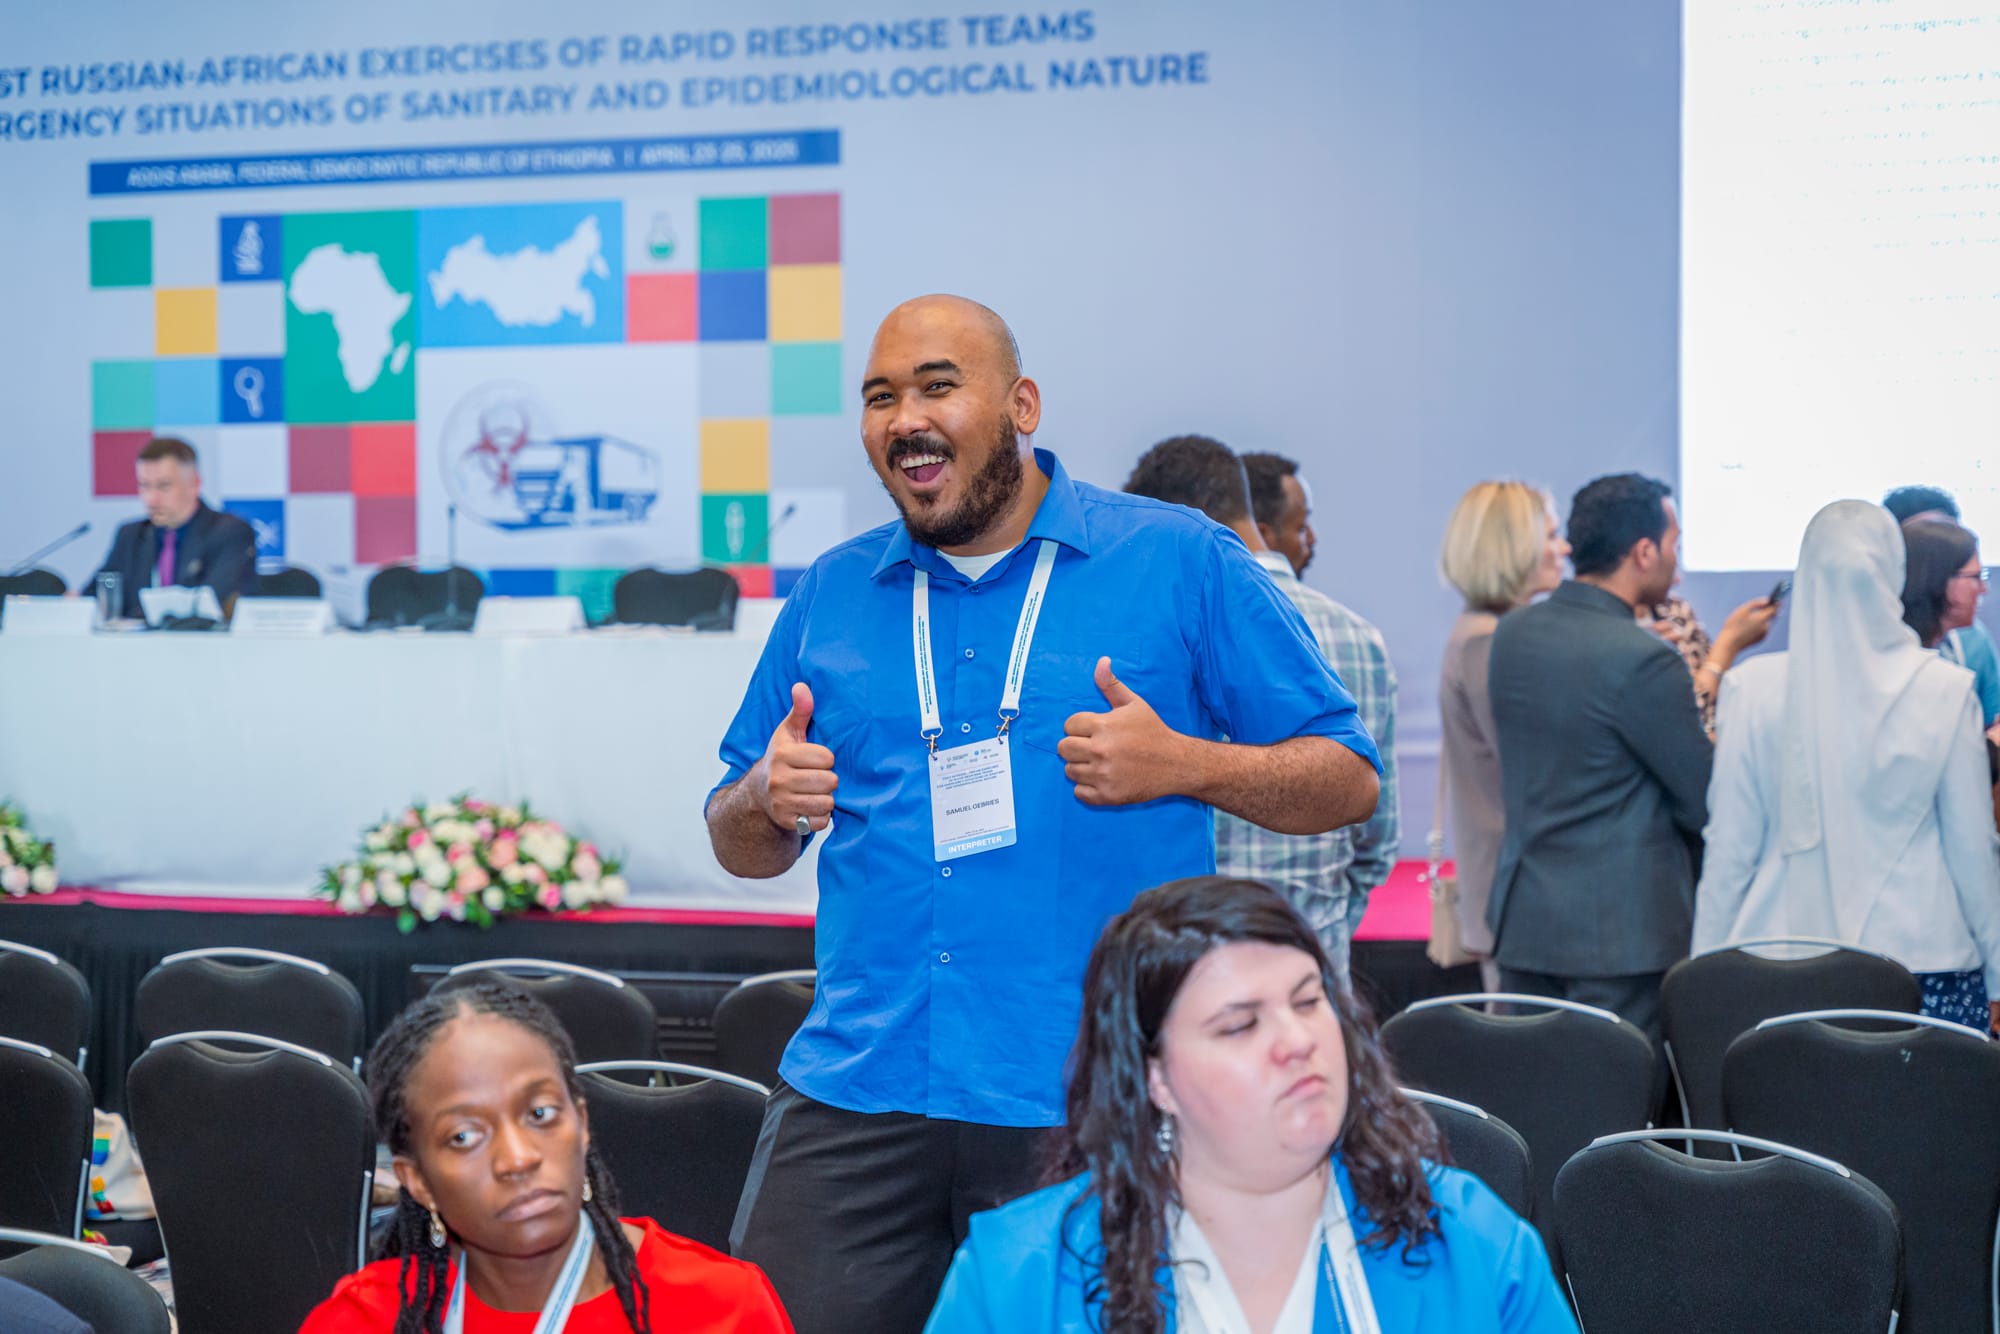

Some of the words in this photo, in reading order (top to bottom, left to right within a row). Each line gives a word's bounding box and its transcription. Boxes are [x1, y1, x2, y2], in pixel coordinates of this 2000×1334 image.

[40, 52, 348, 96] RUSSIAN-AFRICAN
[358, 39, 548, 79] EXERCISES
[558, 36, 606, 68] OF
[619, 30, 735, 63] RAPID
[746, 18, 948, 58] RESPONSE
[962, 10, 1096, 48] TEAMS
[135, 95, 335, 135] SITUATIONS
[344, 92, 388, 125] OF
[402, 84, 575, 122] SANITARY
[587, 79, 669, 110] AND
[681, 63, 1035, 108] EPIDEMIOLOGICAL
[1048, 51, 1209, 89] NATURE
[945, 804, 972, 816] SAMUEL
[948, 835, 1003, 854] INTERPRETER
